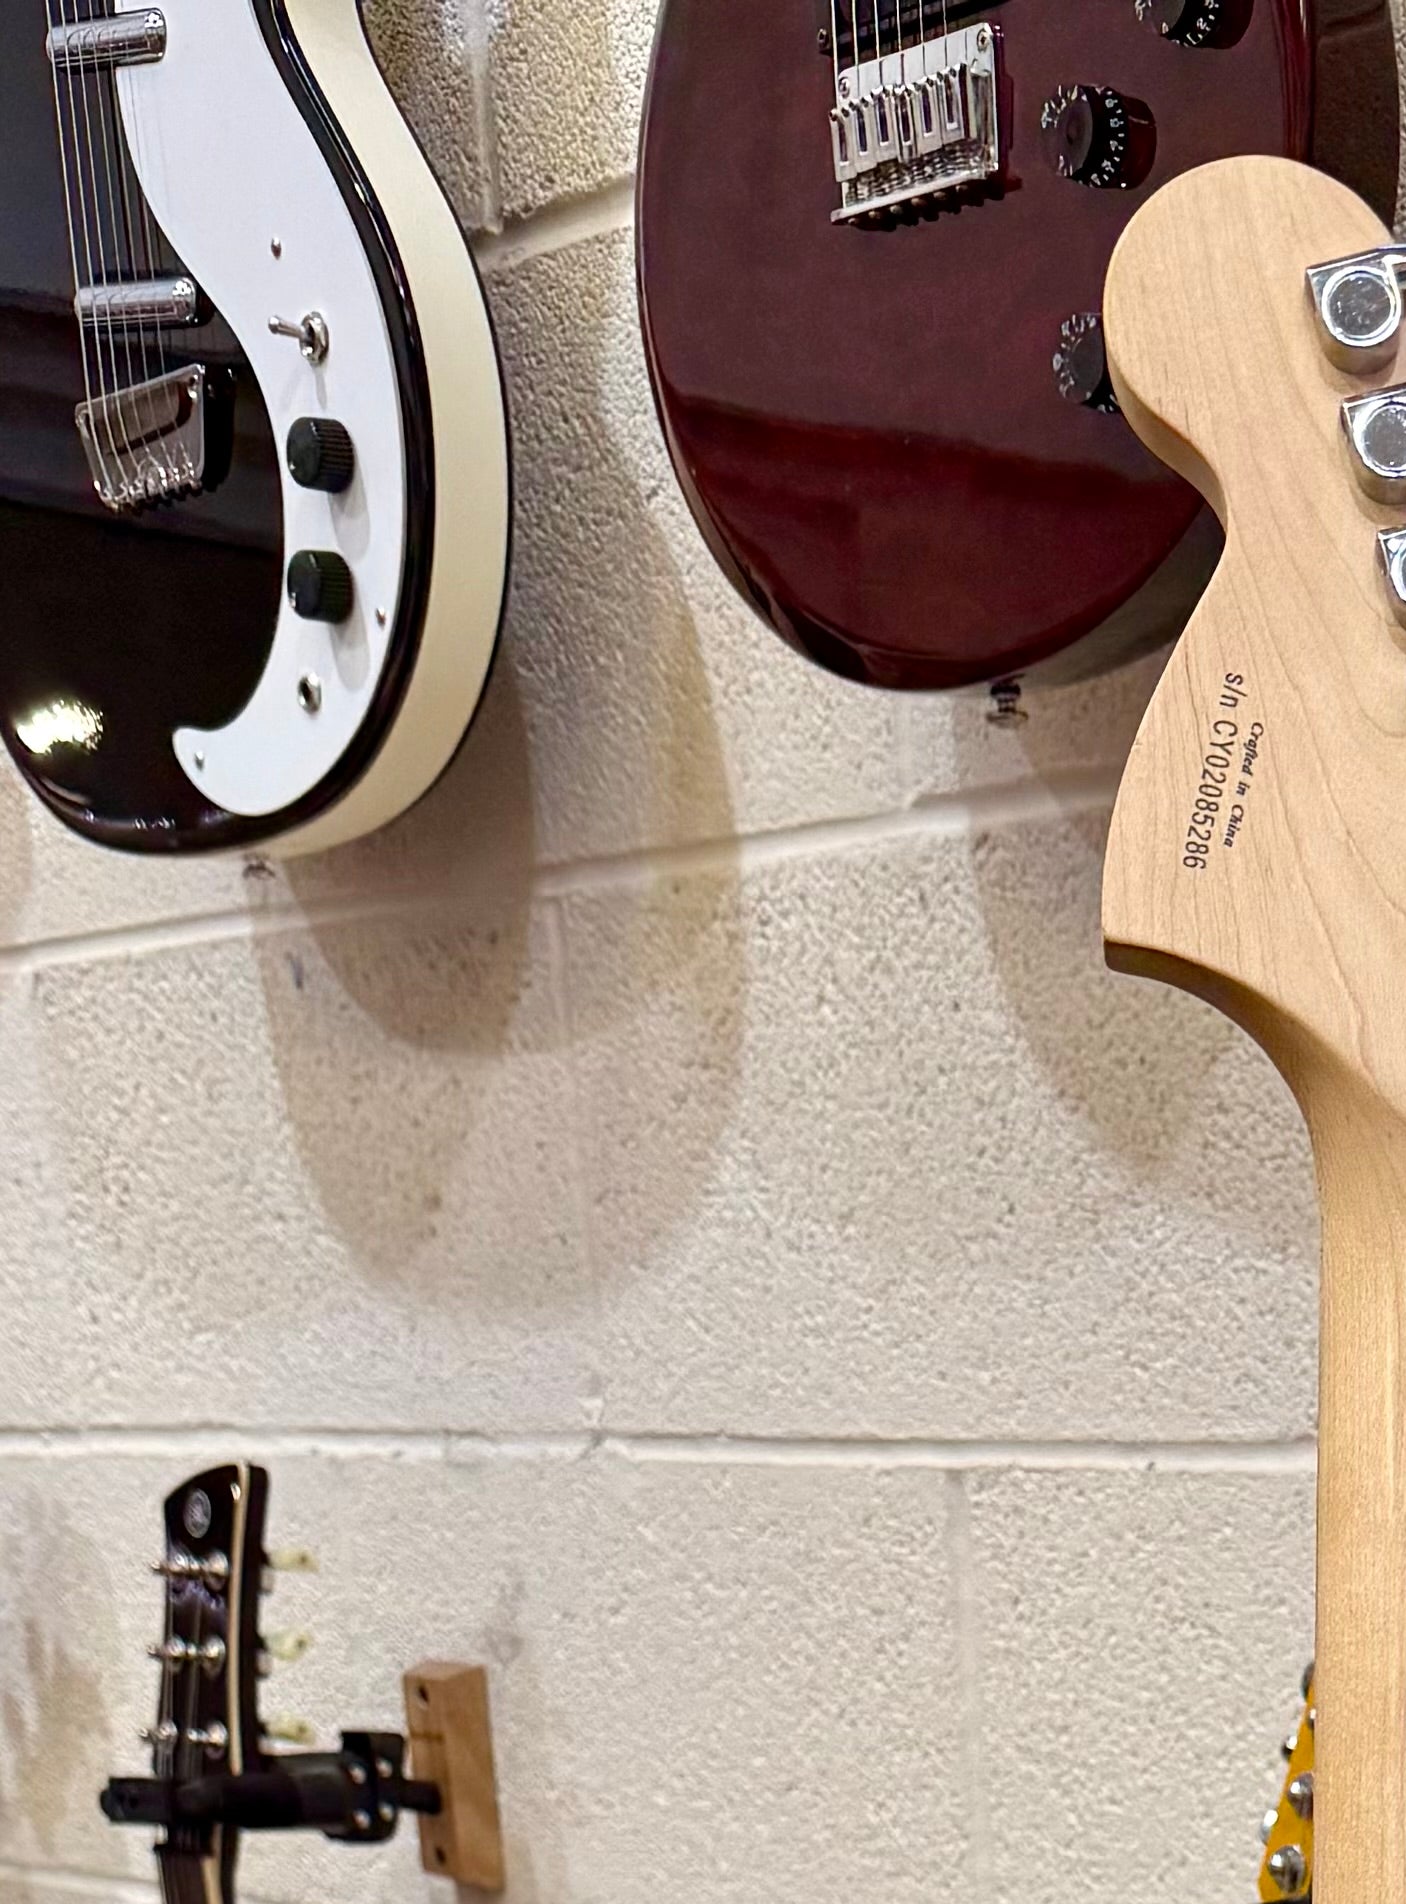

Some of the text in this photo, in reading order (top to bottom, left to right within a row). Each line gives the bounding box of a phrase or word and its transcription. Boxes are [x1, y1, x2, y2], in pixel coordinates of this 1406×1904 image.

[1183, 672, 1248, 870] s/n CY02085286
[1223, 721, 1265, 848] Crafted in China
